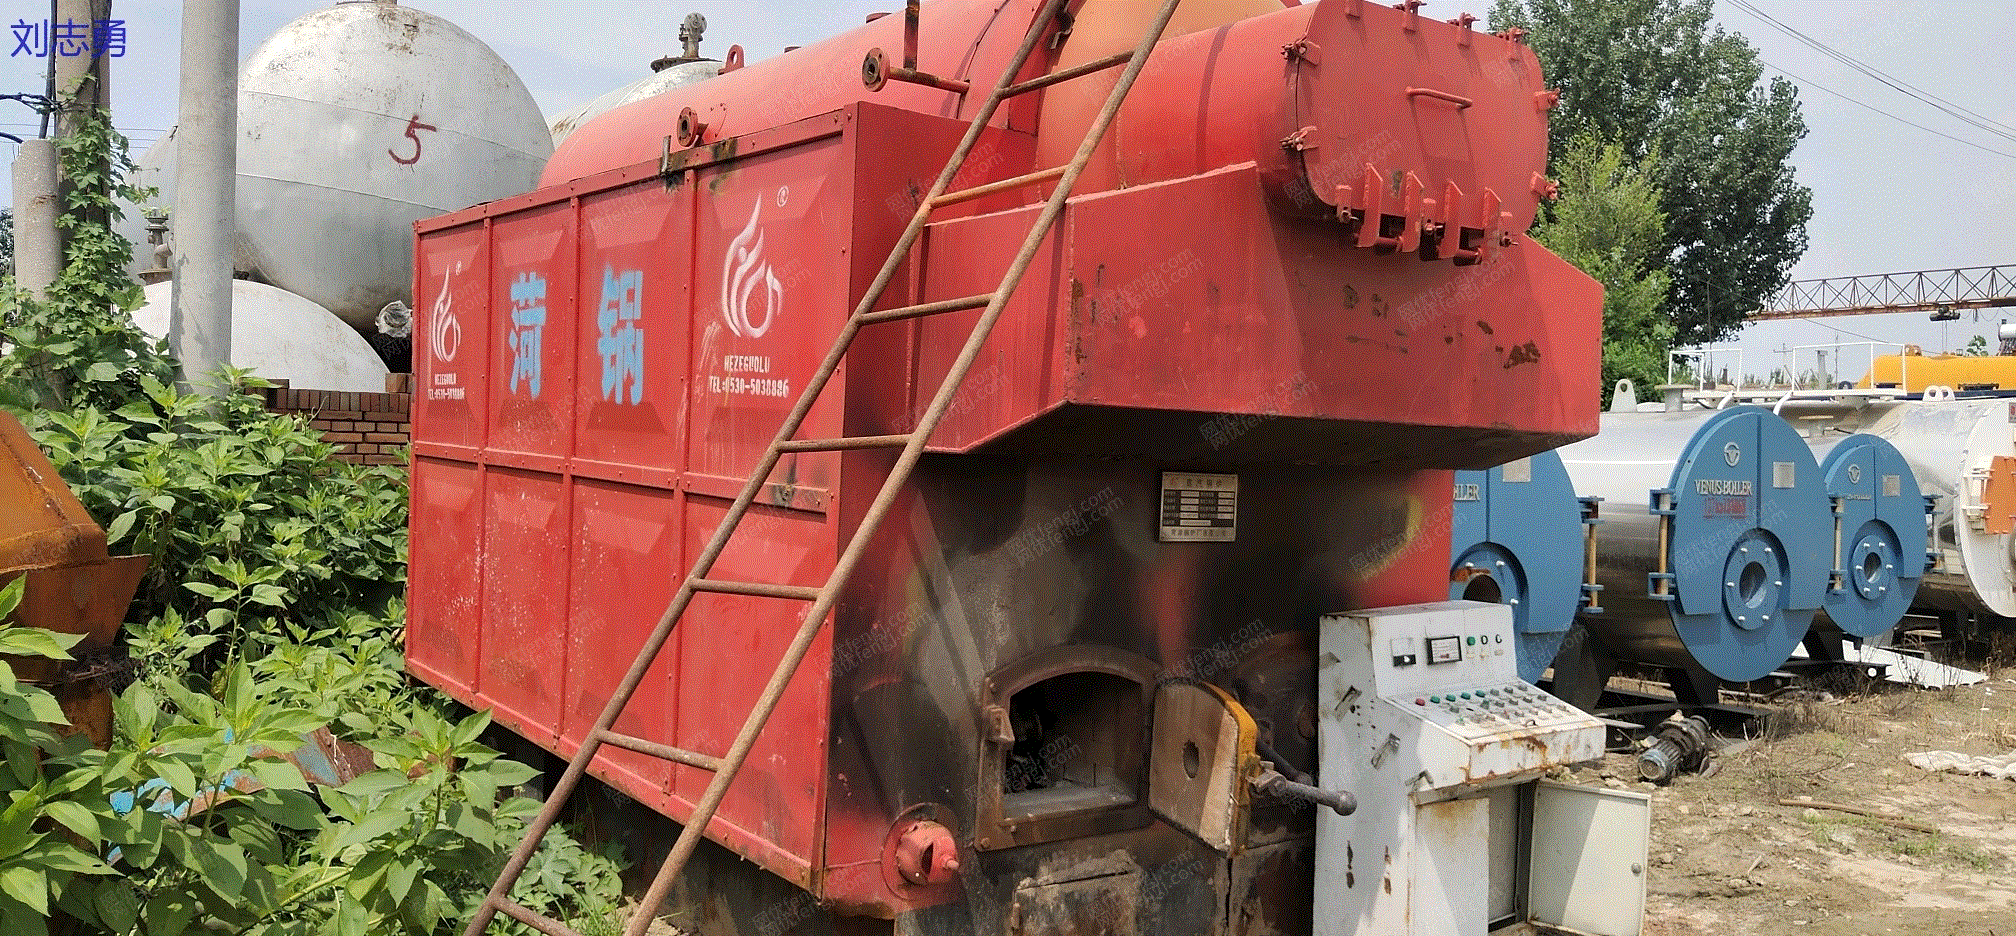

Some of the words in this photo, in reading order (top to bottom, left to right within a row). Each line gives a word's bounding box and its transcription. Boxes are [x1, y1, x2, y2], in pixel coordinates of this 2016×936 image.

[388, 112, 437, 166] 5
[1694, 479, 1722, 496] VENUS
[1723, 480, 1752, 497] BOILER
